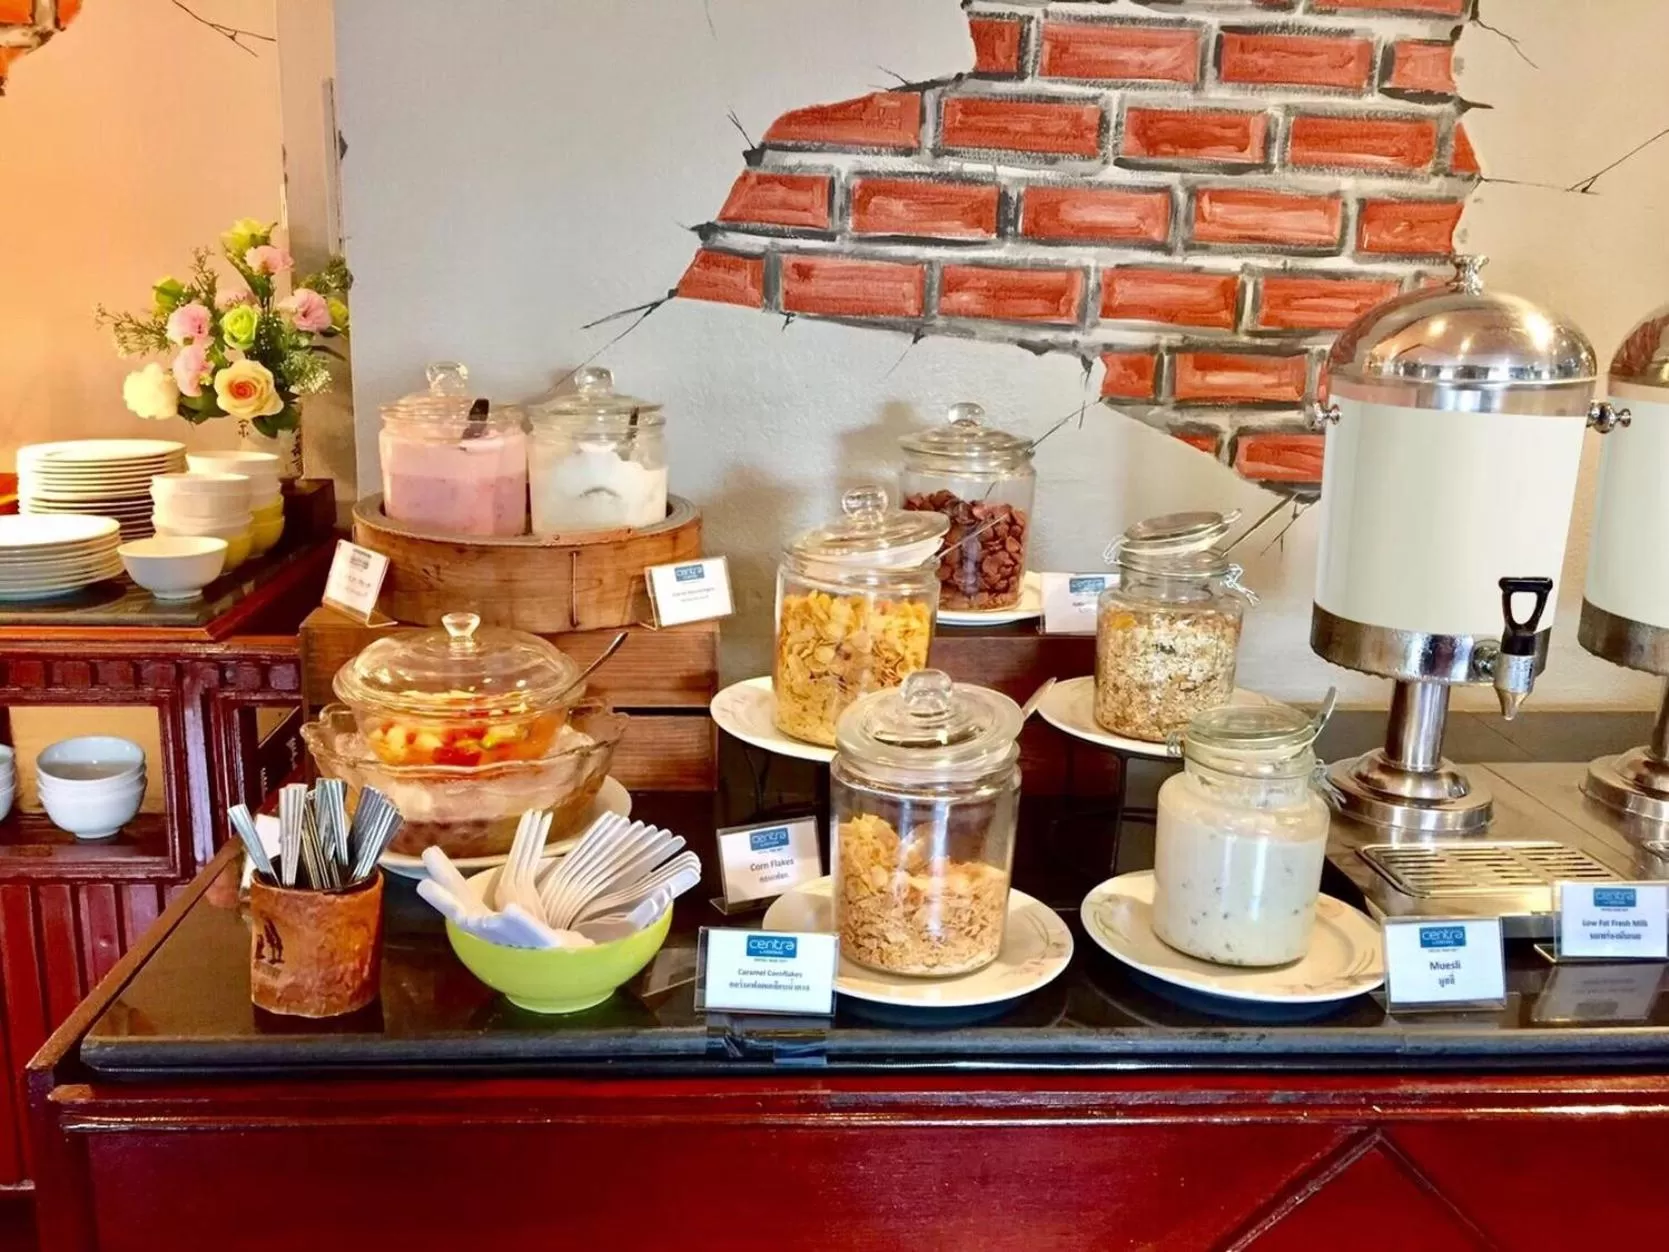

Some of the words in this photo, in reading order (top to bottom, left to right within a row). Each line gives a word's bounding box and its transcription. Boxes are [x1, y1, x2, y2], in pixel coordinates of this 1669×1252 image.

[750, 862, 769, 872] Corn
[770, 858, 794, 868] Flakes
[1582, 919, 1597, 927] Low
[1599, 919, 1610, 927] Fat
[1611, 919, 1631, 927] Fresh
[1632, 919, 1648, 927] Milk
[1422, 929, 1463, 940] centra
[749, 939, 795, 950] centra
[1429, 960, 1461, 970] Muesli
[738, 968, 766, 977] Caramel
[767, 969, 803, 978] Cornflakes
